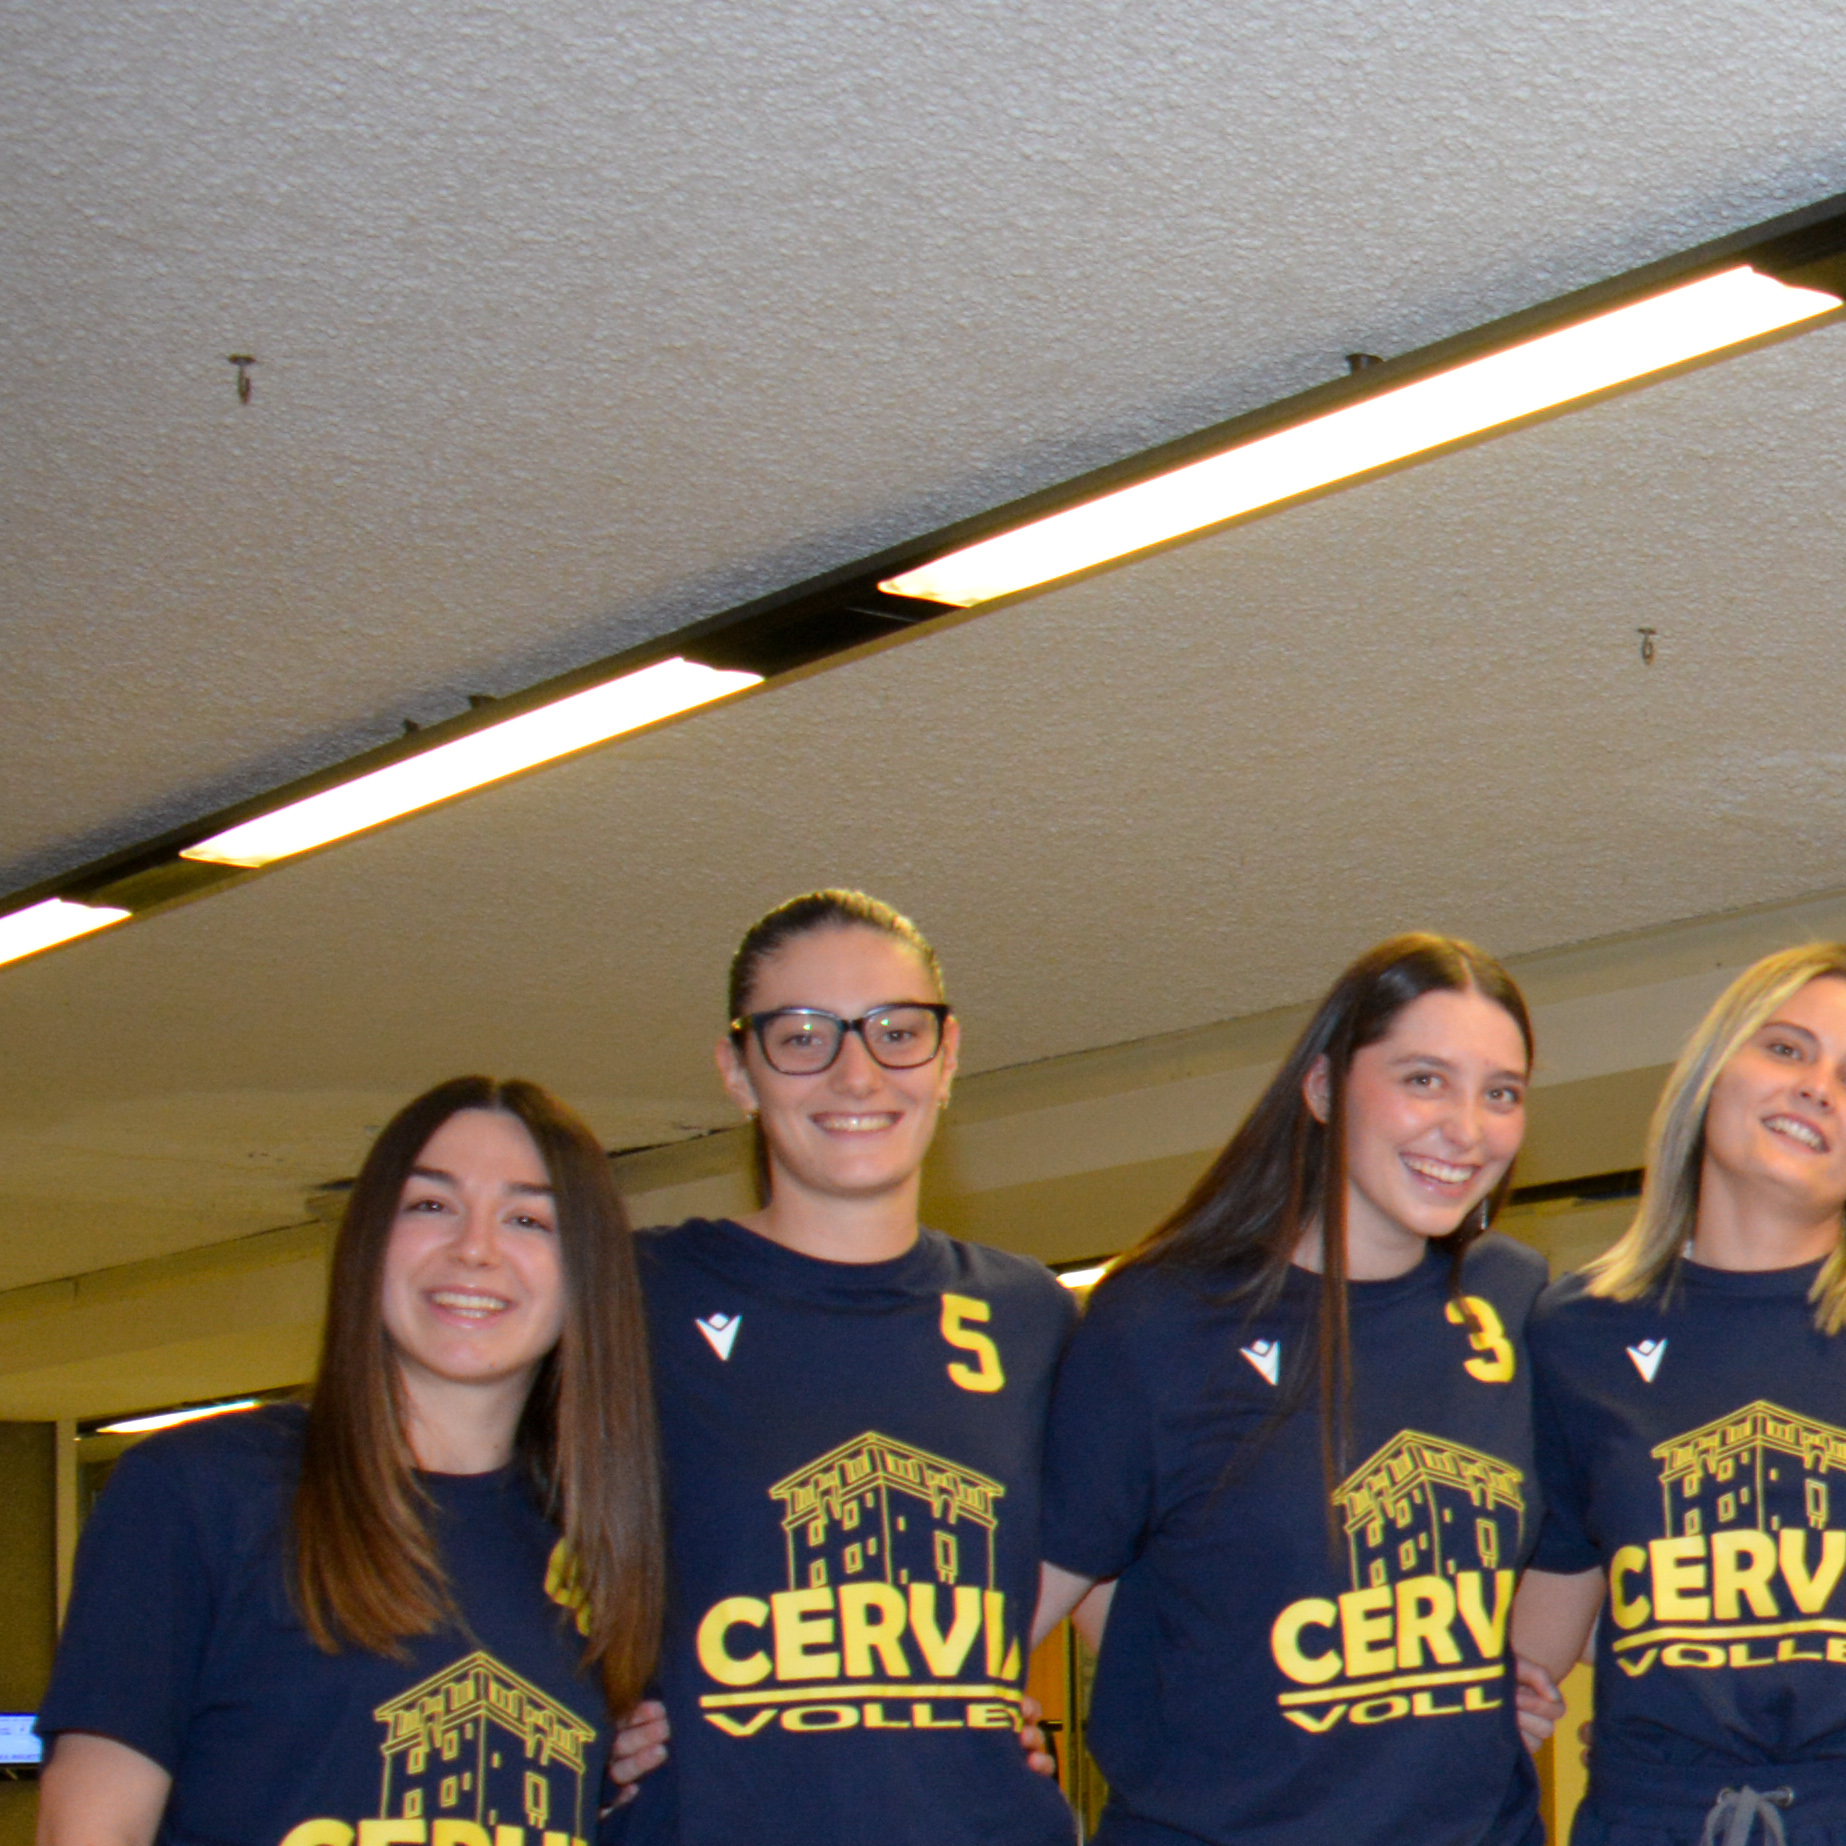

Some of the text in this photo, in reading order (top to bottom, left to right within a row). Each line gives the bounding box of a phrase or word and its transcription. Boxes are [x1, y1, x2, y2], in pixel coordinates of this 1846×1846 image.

[941, 1291, 1006, 1393] 5
[1445, 1296, 1516, 1384] 3
[1270, 1568, 1516, 1686] CERV
[1282, 1686, 1504, 1734] VOLL
